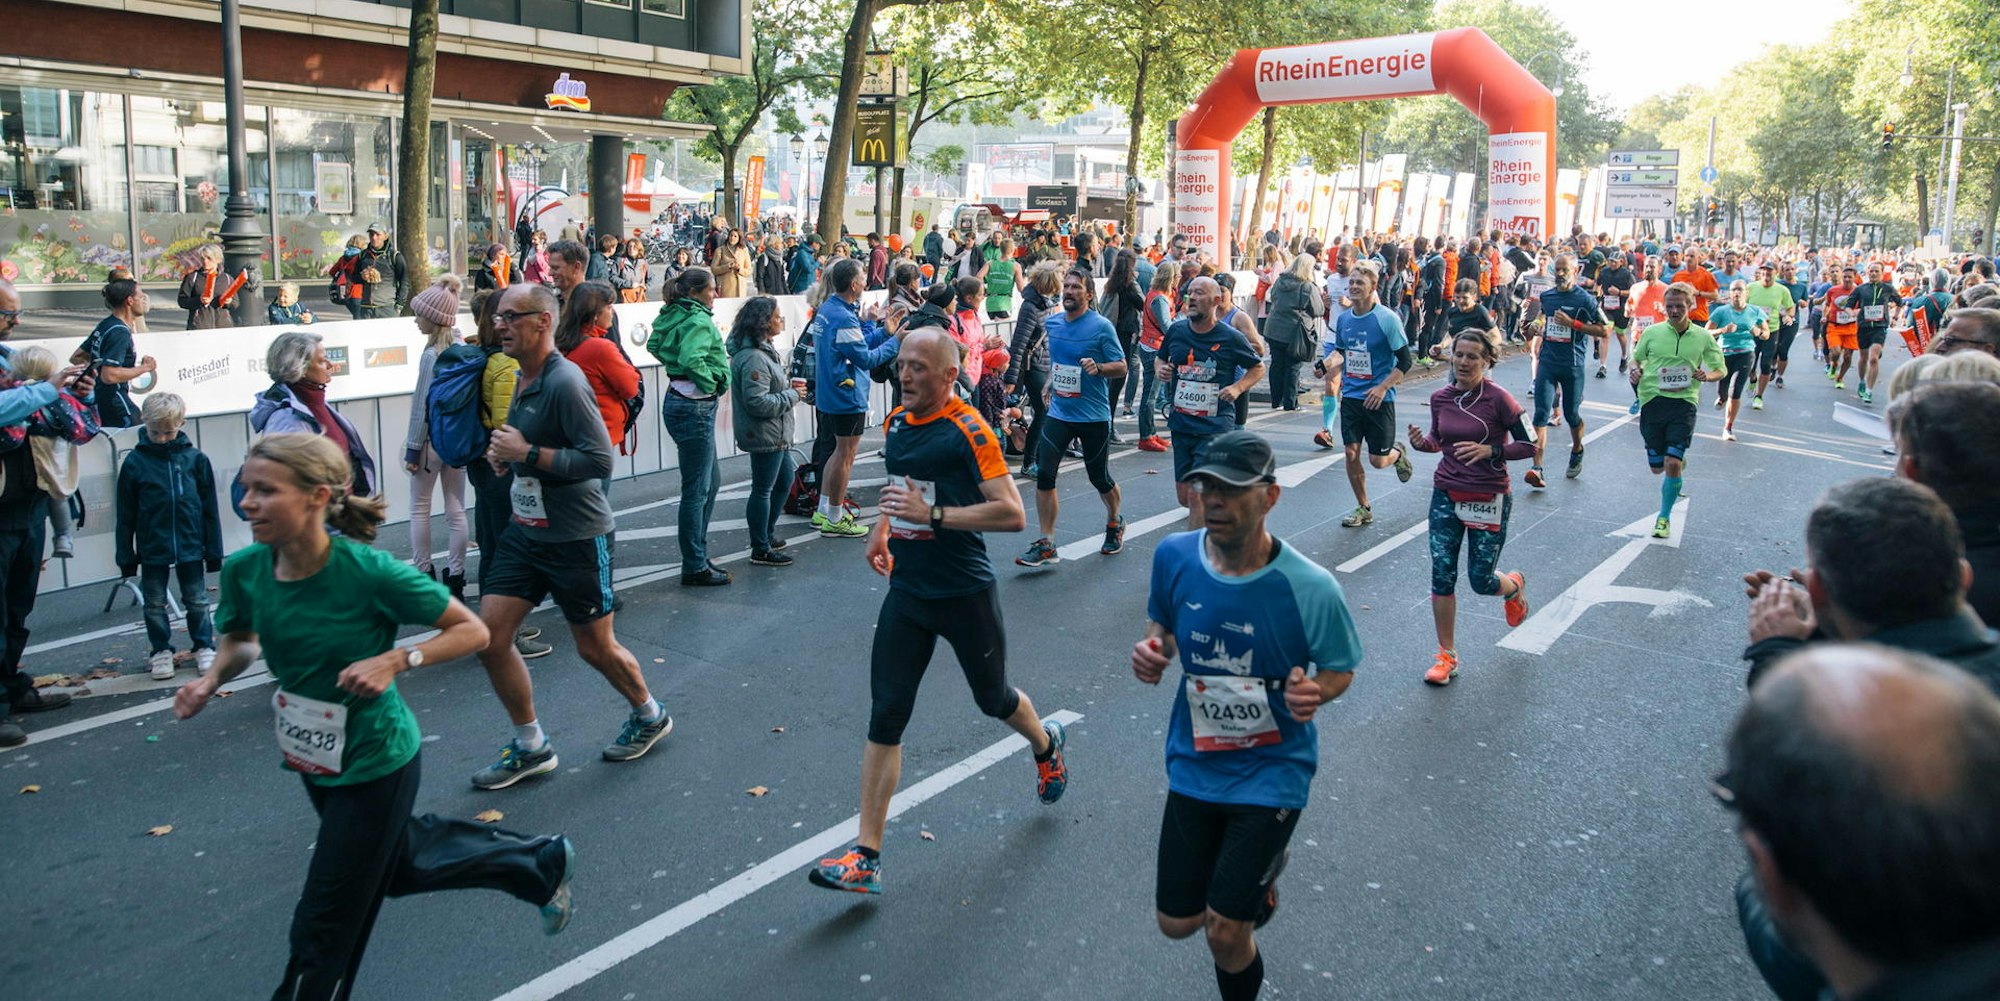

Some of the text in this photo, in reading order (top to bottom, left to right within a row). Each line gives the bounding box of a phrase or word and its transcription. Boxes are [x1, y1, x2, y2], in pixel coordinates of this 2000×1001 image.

[1260, 49, 1425, 82] RheinEnergie
[553, 73, 586, 97] dm
[1493, 159, 1532, 173] Rhein
[178, 354, 230, 380] Reissdorf
[1053, 374, 1077, 385] 23289
[1178, 391, 1206, 402] 24600
[1460, 502, 1497, 514] F16441
[1199, 702, 1261, 720] 12430
